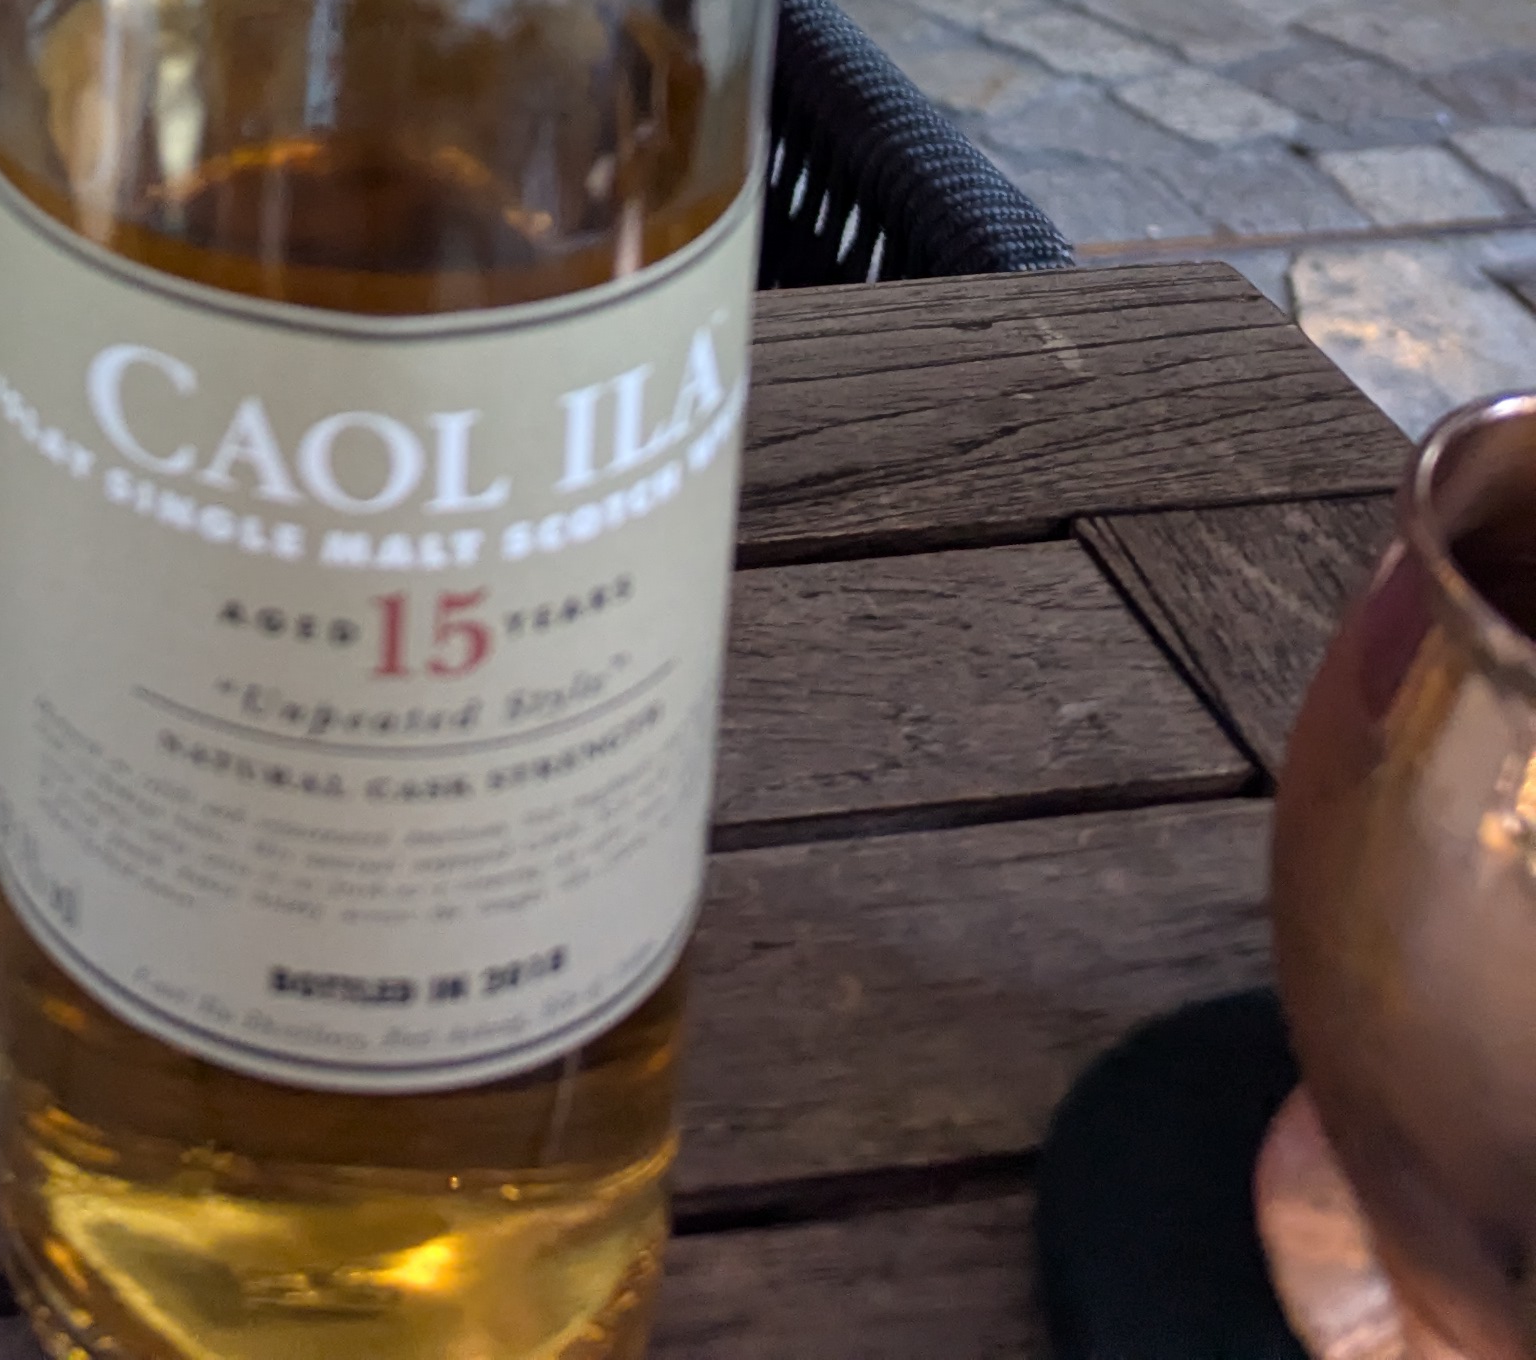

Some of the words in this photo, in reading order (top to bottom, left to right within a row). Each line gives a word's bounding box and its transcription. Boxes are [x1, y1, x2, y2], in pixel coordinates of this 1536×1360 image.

[85, 342, 513, 515] CAOL
[554, 322, 730, 494] ILA
[319, 528, 487, 570] MALT
[216, 597, 362, 651] AGED
[367, 582, 495, 680] 15
[505, 572, 634, 638] YEARS
